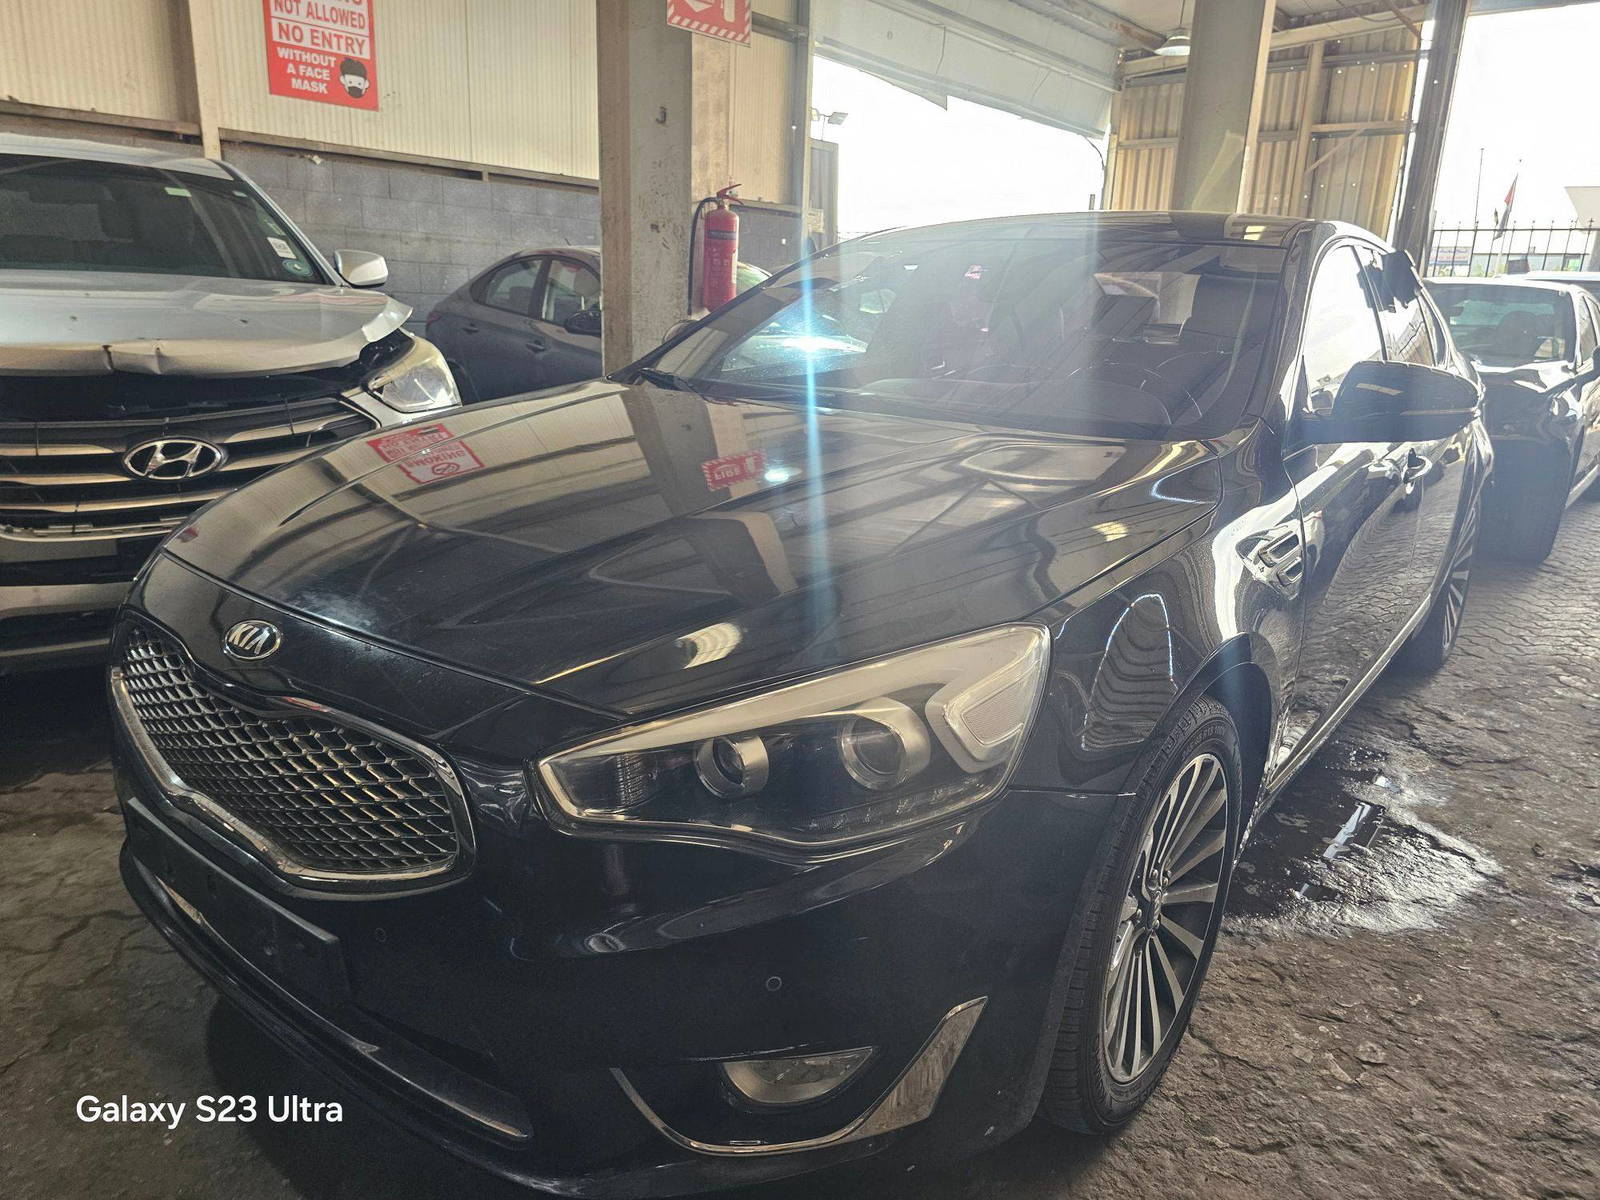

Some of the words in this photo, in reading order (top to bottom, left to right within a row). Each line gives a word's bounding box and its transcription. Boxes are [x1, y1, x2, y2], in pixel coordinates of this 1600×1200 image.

[274, 0, 301, 16] NOT
[306, 2, 366, 29] ALLOWED
[278, 22, 304, 43] NO
[310, 28, 366, 55] ENTRY
[276, 46, 337, 67] WITHOUT
[286, 63, 297, 75] A
[299, 65, 331, 81] FACE
[291, 78, 328, 94] MASK
[227, 623, 271, 655] KIA
